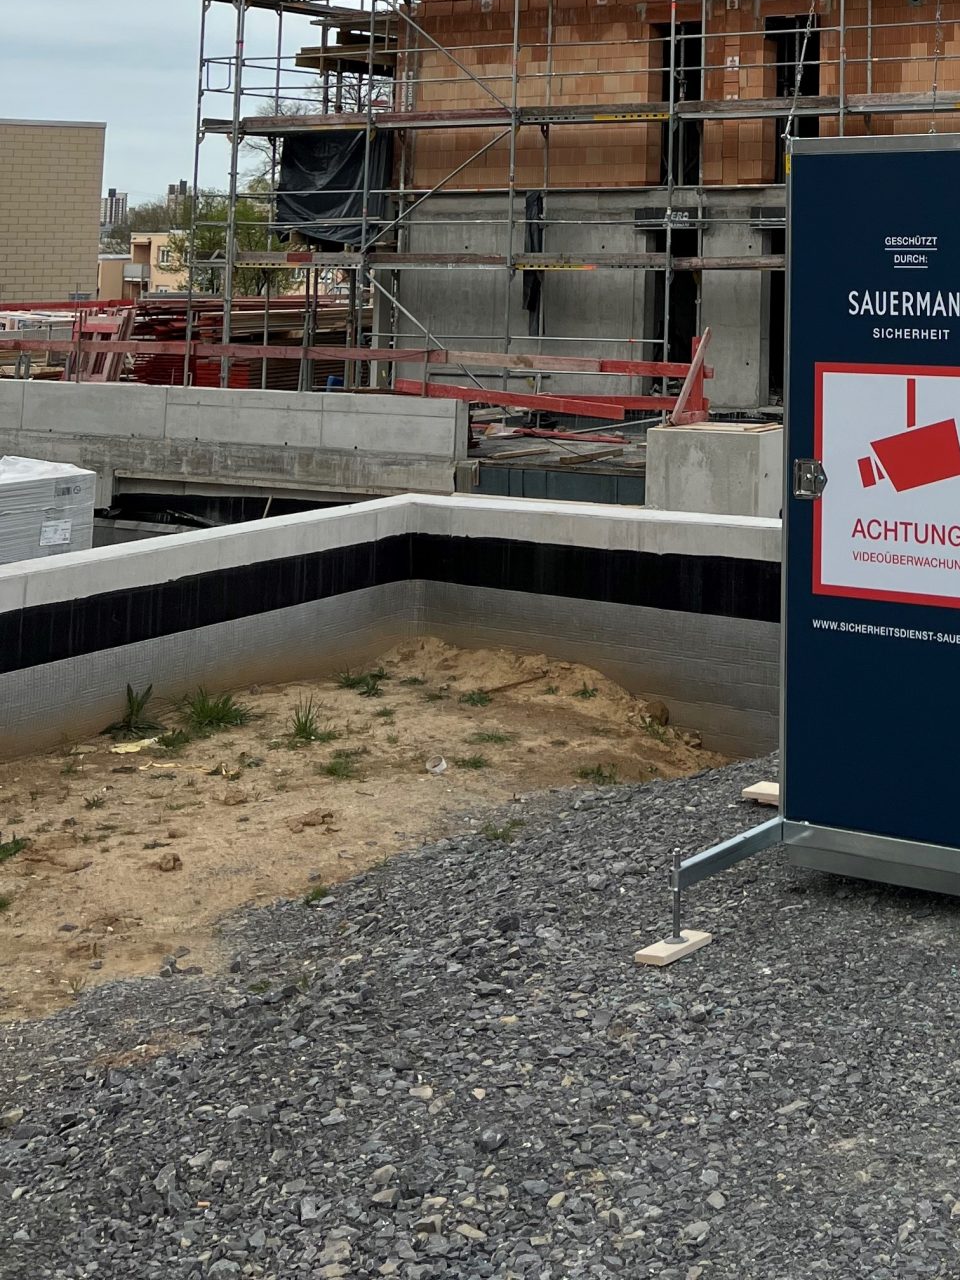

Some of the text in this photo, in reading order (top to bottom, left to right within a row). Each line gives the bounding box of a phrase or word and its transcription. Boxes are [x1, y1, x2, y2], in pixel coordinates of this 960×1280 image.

[885, 235, 938, 246] GESCHÜTZT
[894, 254, 928, 264] DURCH:
[872, 328, 950, 340] SICHERHEIT
